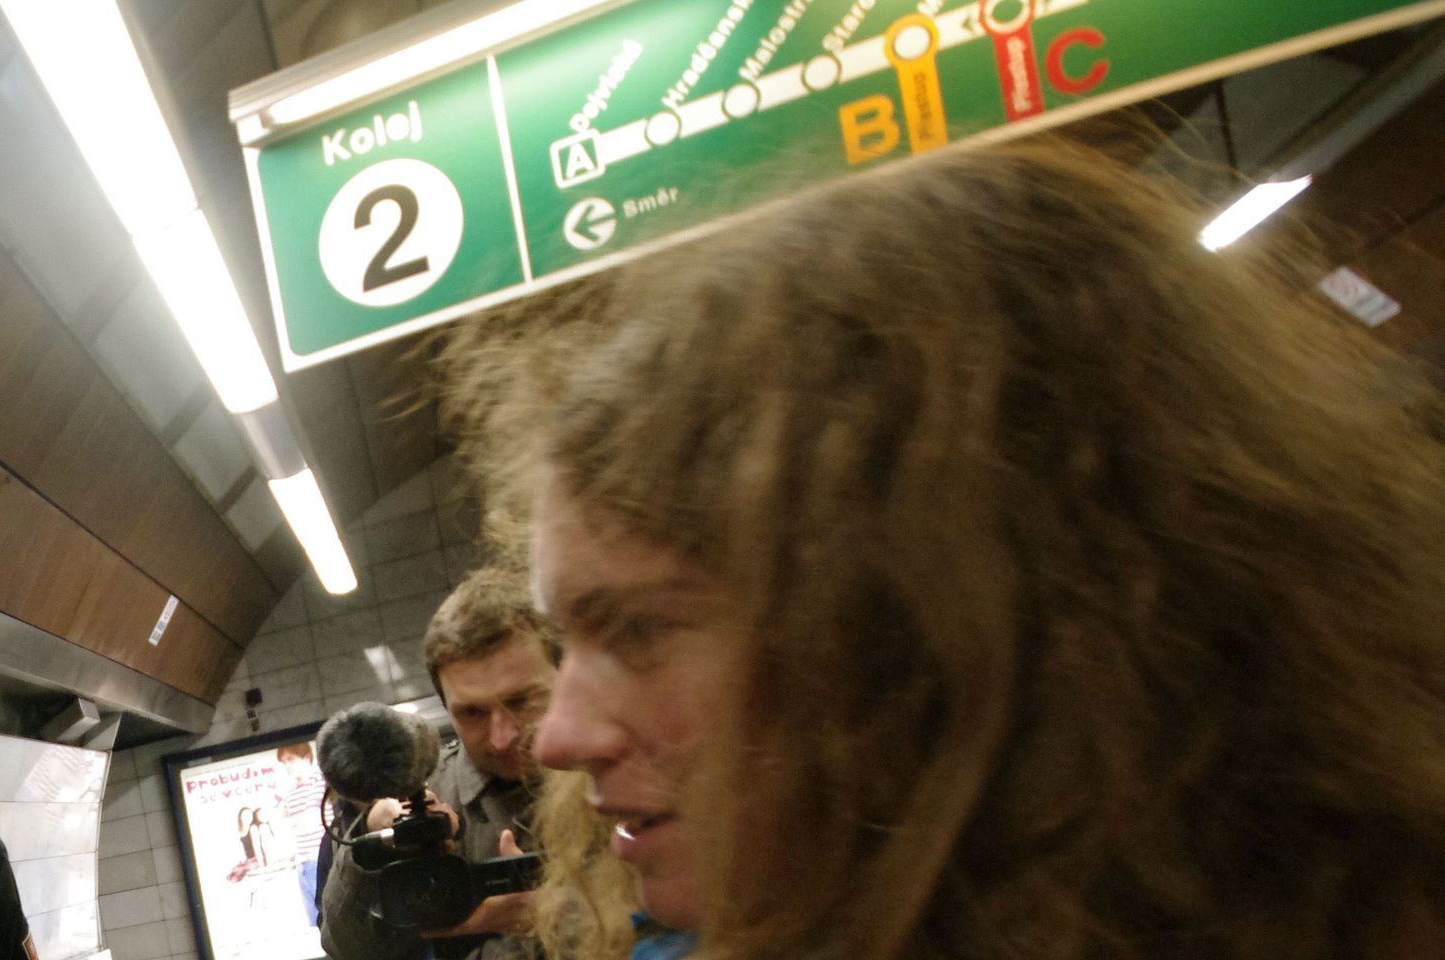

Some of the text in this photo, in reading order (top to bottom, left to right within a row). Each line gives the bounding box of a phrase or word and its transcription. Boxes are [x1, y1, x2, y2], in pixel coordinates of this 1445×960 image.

[1045, 26, 1110, 95] C
[321, 100, 423, 166] Kolej
[565, 142, 596, 178] A
[839, 93, 901, 165] B
[353, 183, 430, 293] 2
